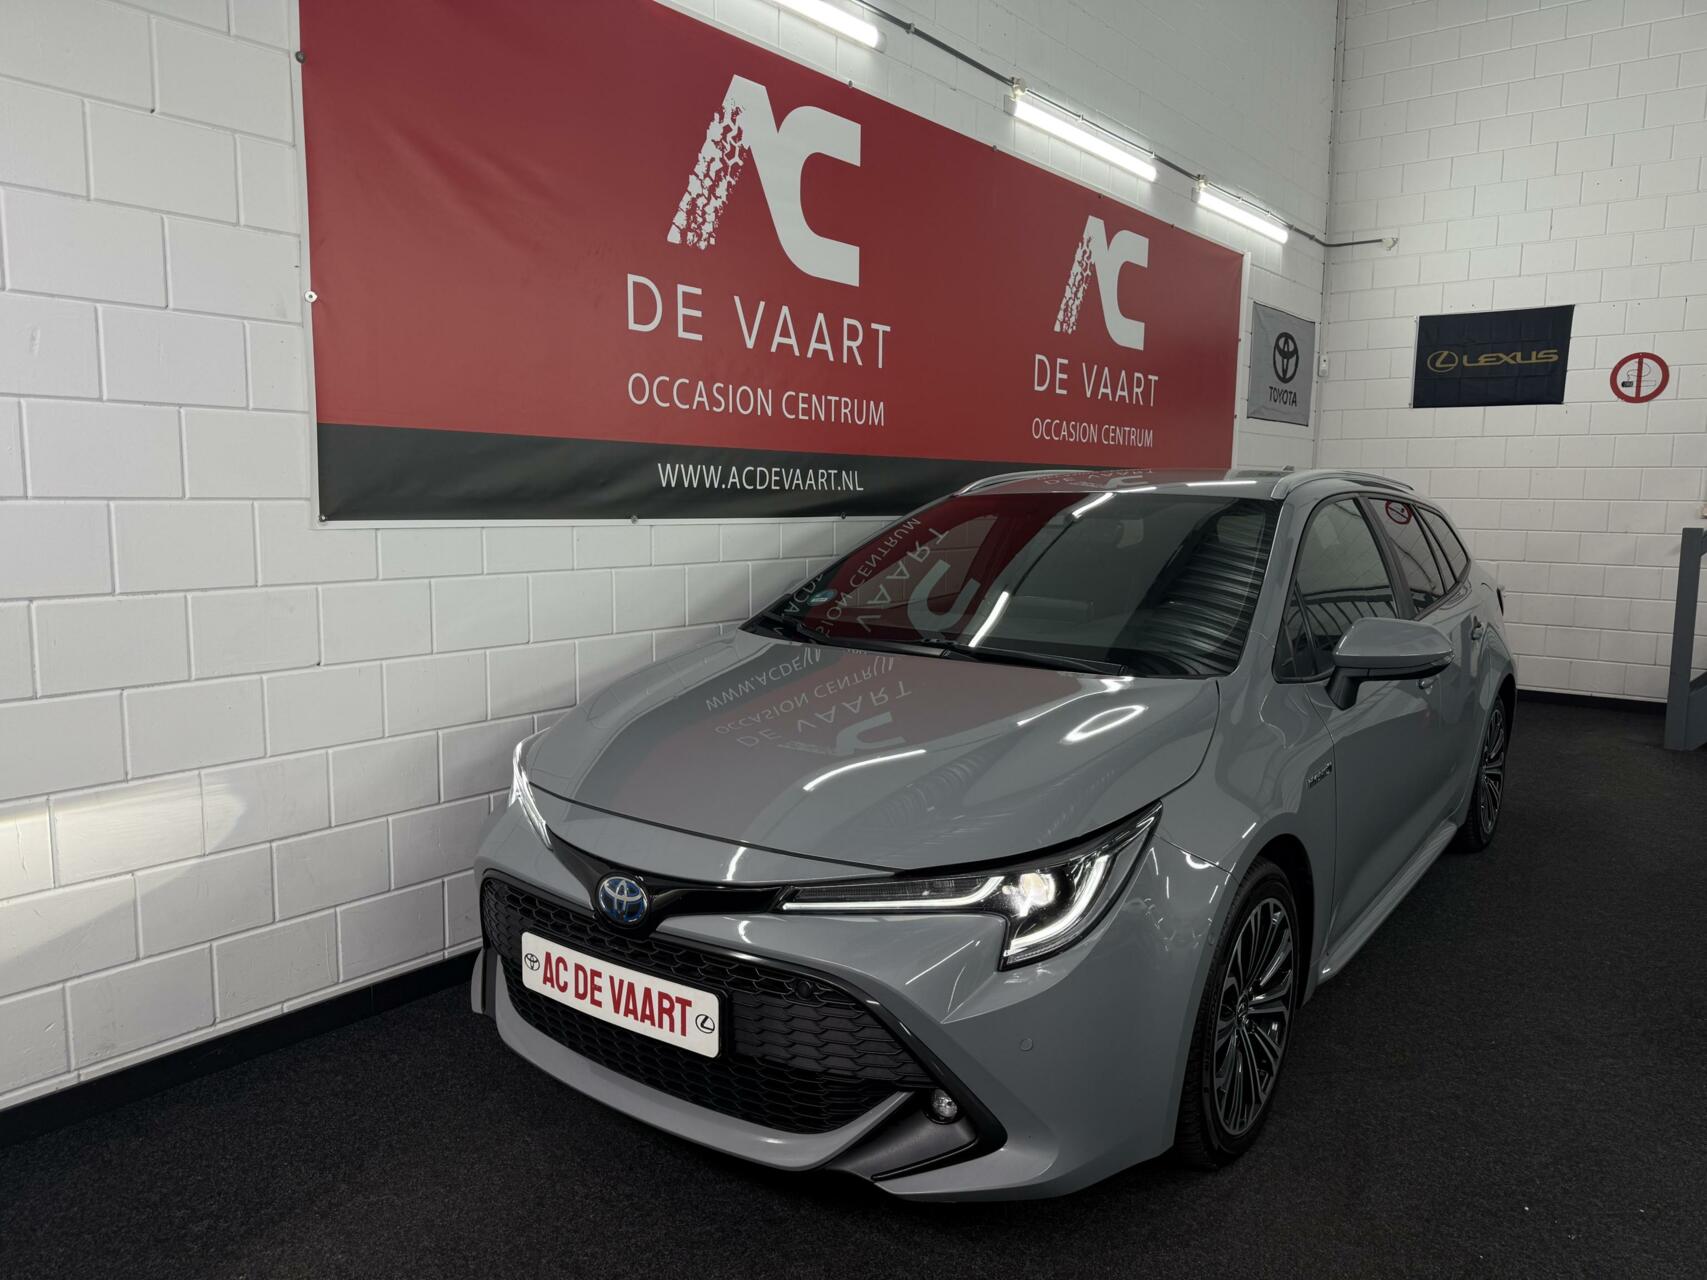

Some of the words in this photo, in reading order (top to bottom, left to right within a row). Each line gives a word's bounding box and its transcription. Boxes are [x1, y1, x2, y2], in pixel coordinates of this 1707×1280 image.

[667, 74, 861, 287] AC
[1053, 215, 1149, 351] AC
[627, 273, 703, 341] DE
[733, 295, 891, 369] VAART
[1034, 353, 1069, 395] DE
[1082, 362, 1159, 407] VAART
[1463, 350, 1559, 368] LEXUS
[628, 372, 772, 417] OCCASION
[782, 391, 885, 427] CENTRUM
[1268, 385, 1298, 408] TOYOTA
[1032, 417, 1098, 444] OCCASION
[1101, 424, 1153, 448] CENTRUM
[657, 463, 864, 491] WWW.ACDEVAART.NL
[542, 951, 569, 993] AC
[574, 962, 603, 1008] DE
[609, 975, 692, 1037] VAART
